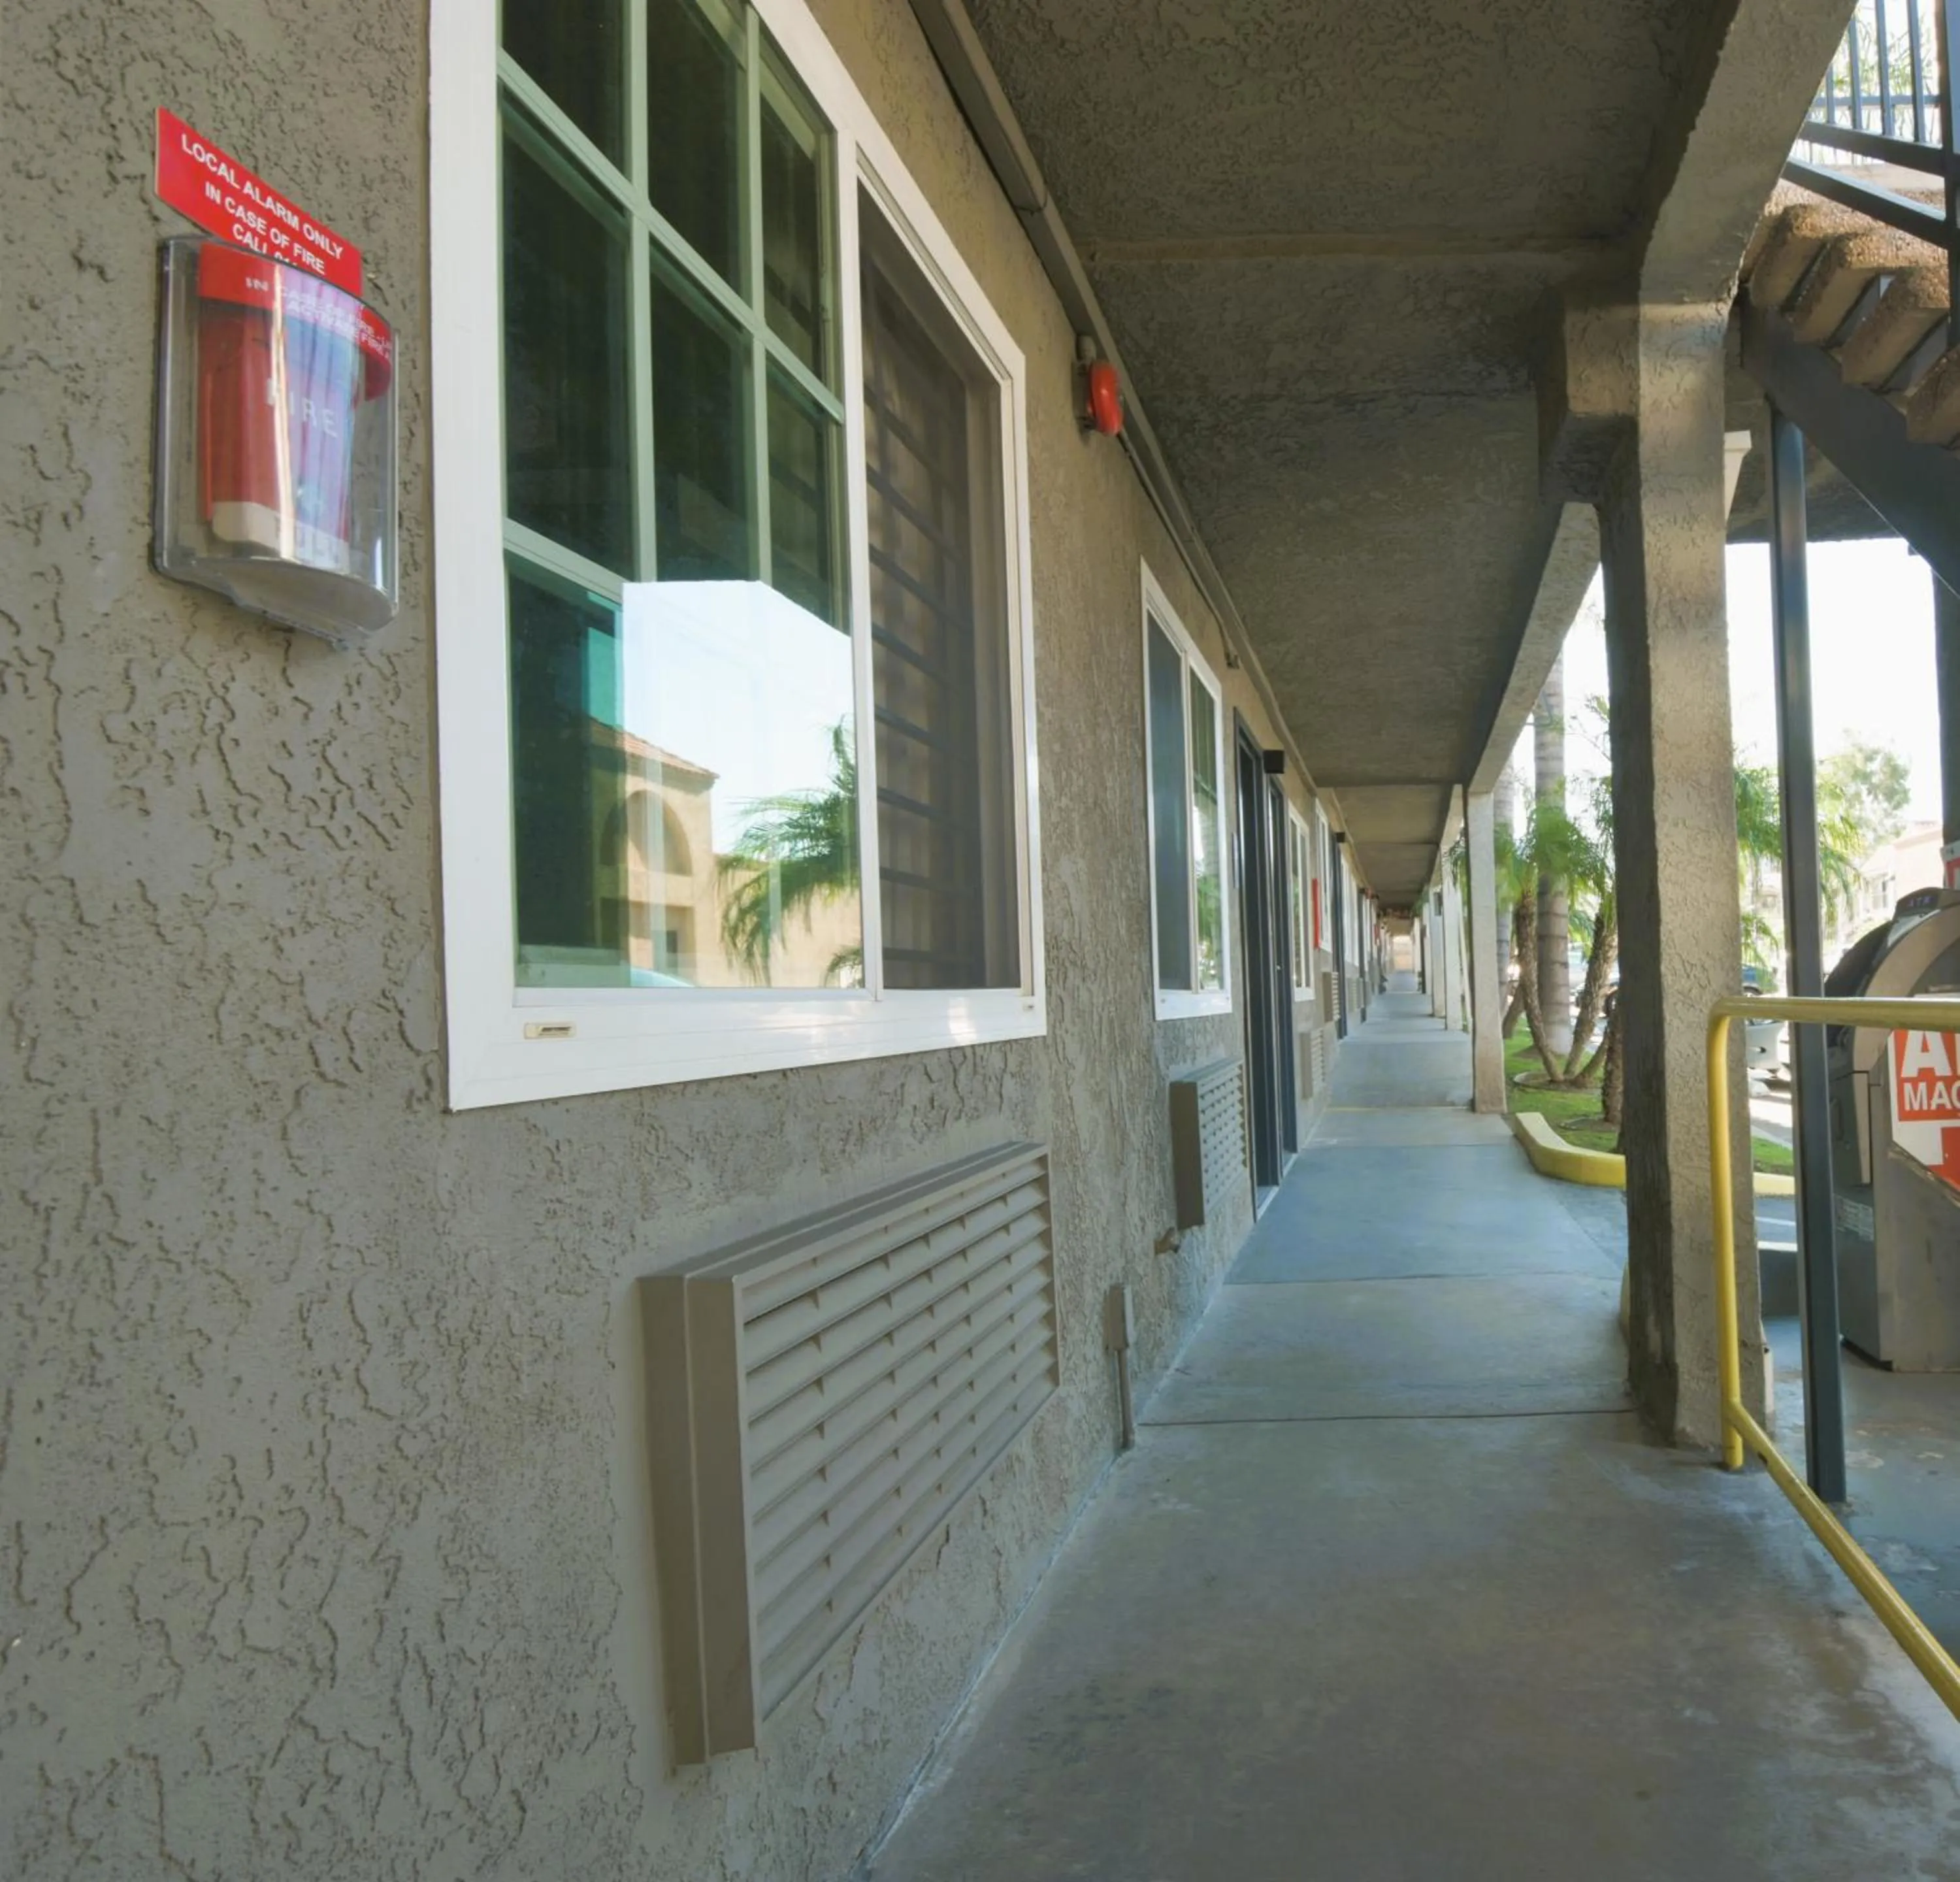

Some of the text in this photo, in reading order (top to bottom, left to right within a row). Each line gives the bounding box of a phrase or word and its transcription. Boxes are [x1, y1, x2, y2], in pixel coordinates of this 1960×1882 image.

[181, 133, 343, 259] LOCAL ALARM ONLY
[204, 181, 221, 205] IN
[225, 196, 267, 236] CASE
[270, 227, 289, 248] OF
[293, 242, 325, 275] FIRE
[1901, 1031, 1960, 1077] A
